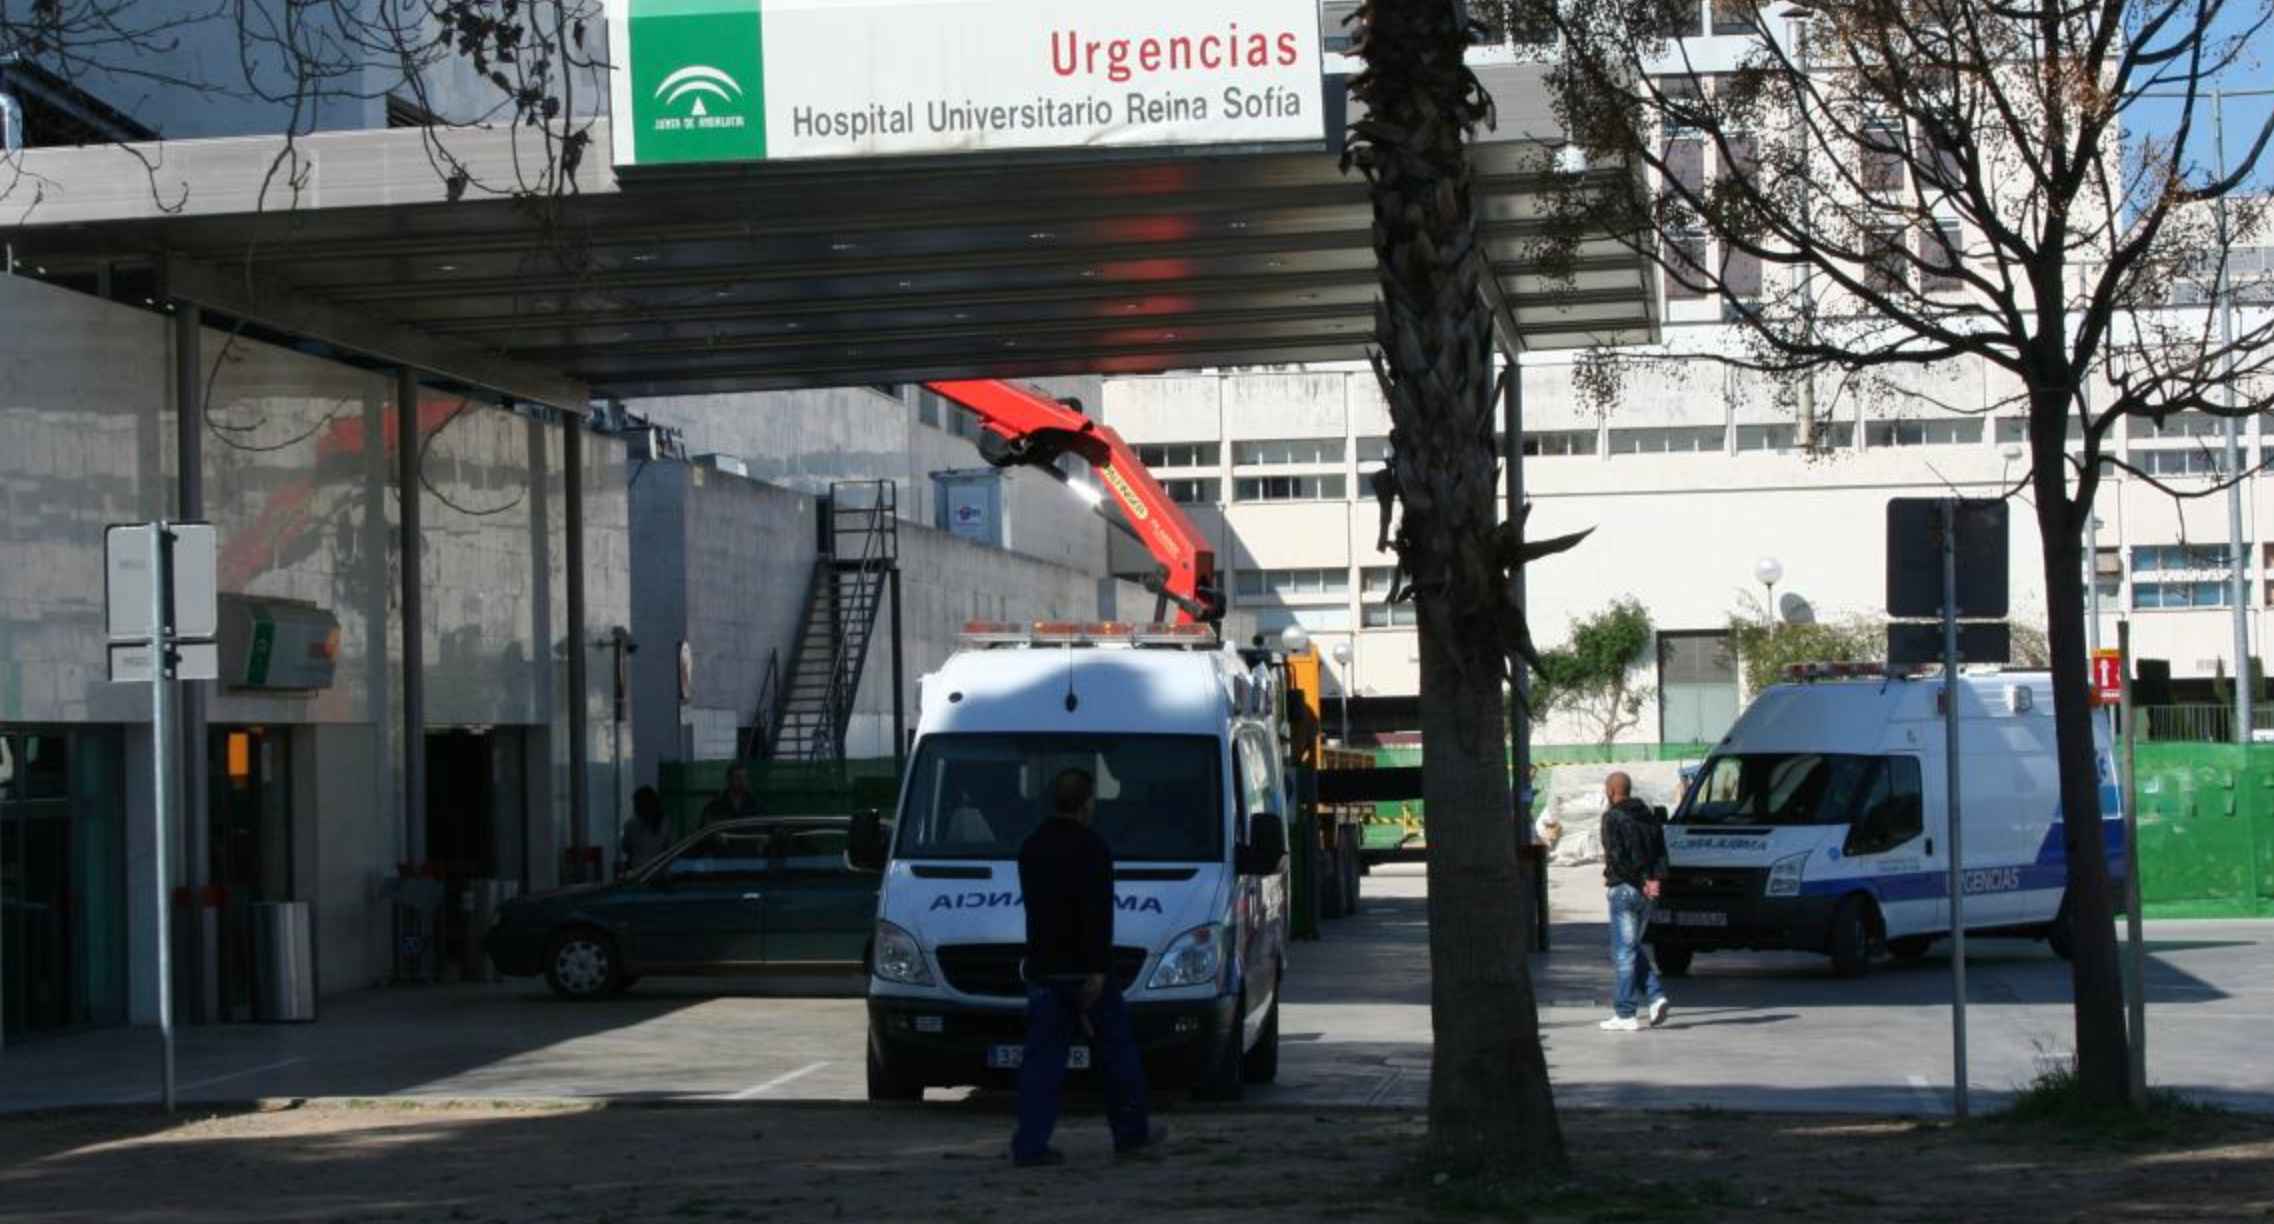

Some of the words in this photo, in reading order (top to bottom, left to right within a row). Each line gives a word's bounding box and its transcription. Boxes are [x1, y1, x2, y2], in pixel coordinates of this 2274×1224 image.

[1052, 22, 1297, 82] Urgencias
[794, 101, 913, 142] Hospital
[928, 97, 1113, 133] Universitario
[1127, 91, 1208, 124] Reina
[1223, 86, 1301, 119] Sofía
